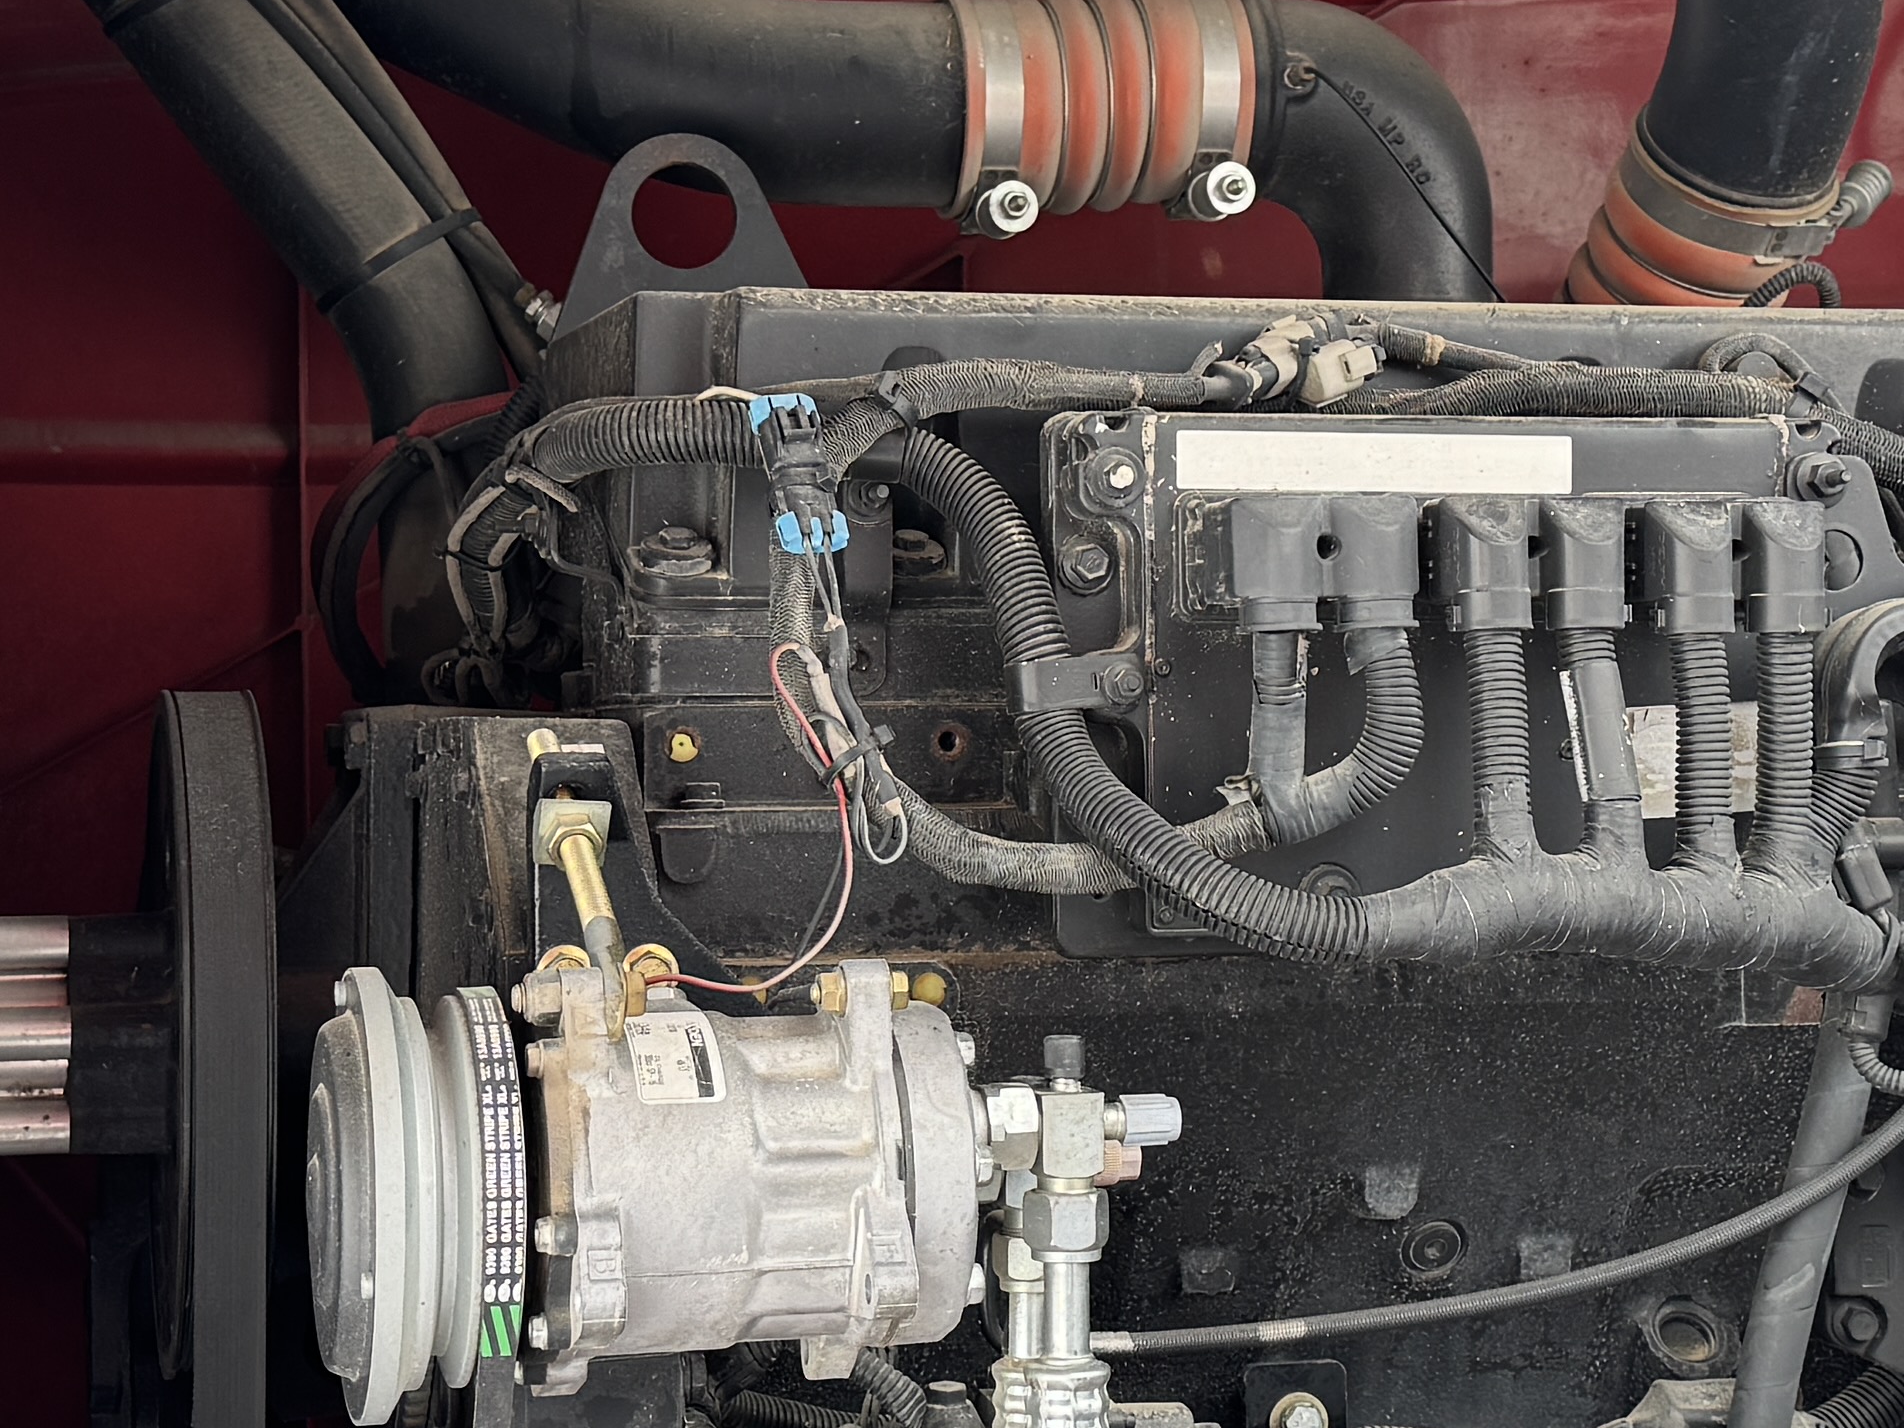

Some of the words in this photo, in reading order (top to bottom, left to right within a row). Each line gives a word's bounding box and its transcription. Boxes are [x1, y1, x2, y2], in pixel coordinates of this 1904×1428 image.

[483, 1107, 495, 1151] STRIPE
[497, 1107, 511, 1150] STRIPE
[485, 1153, 498, 1199] GREEN
[500, 1153, 512, 1198] GREEN
[486, 1201, 497, 1243] GATES
[501, 1201, 512, 1243] GATES
